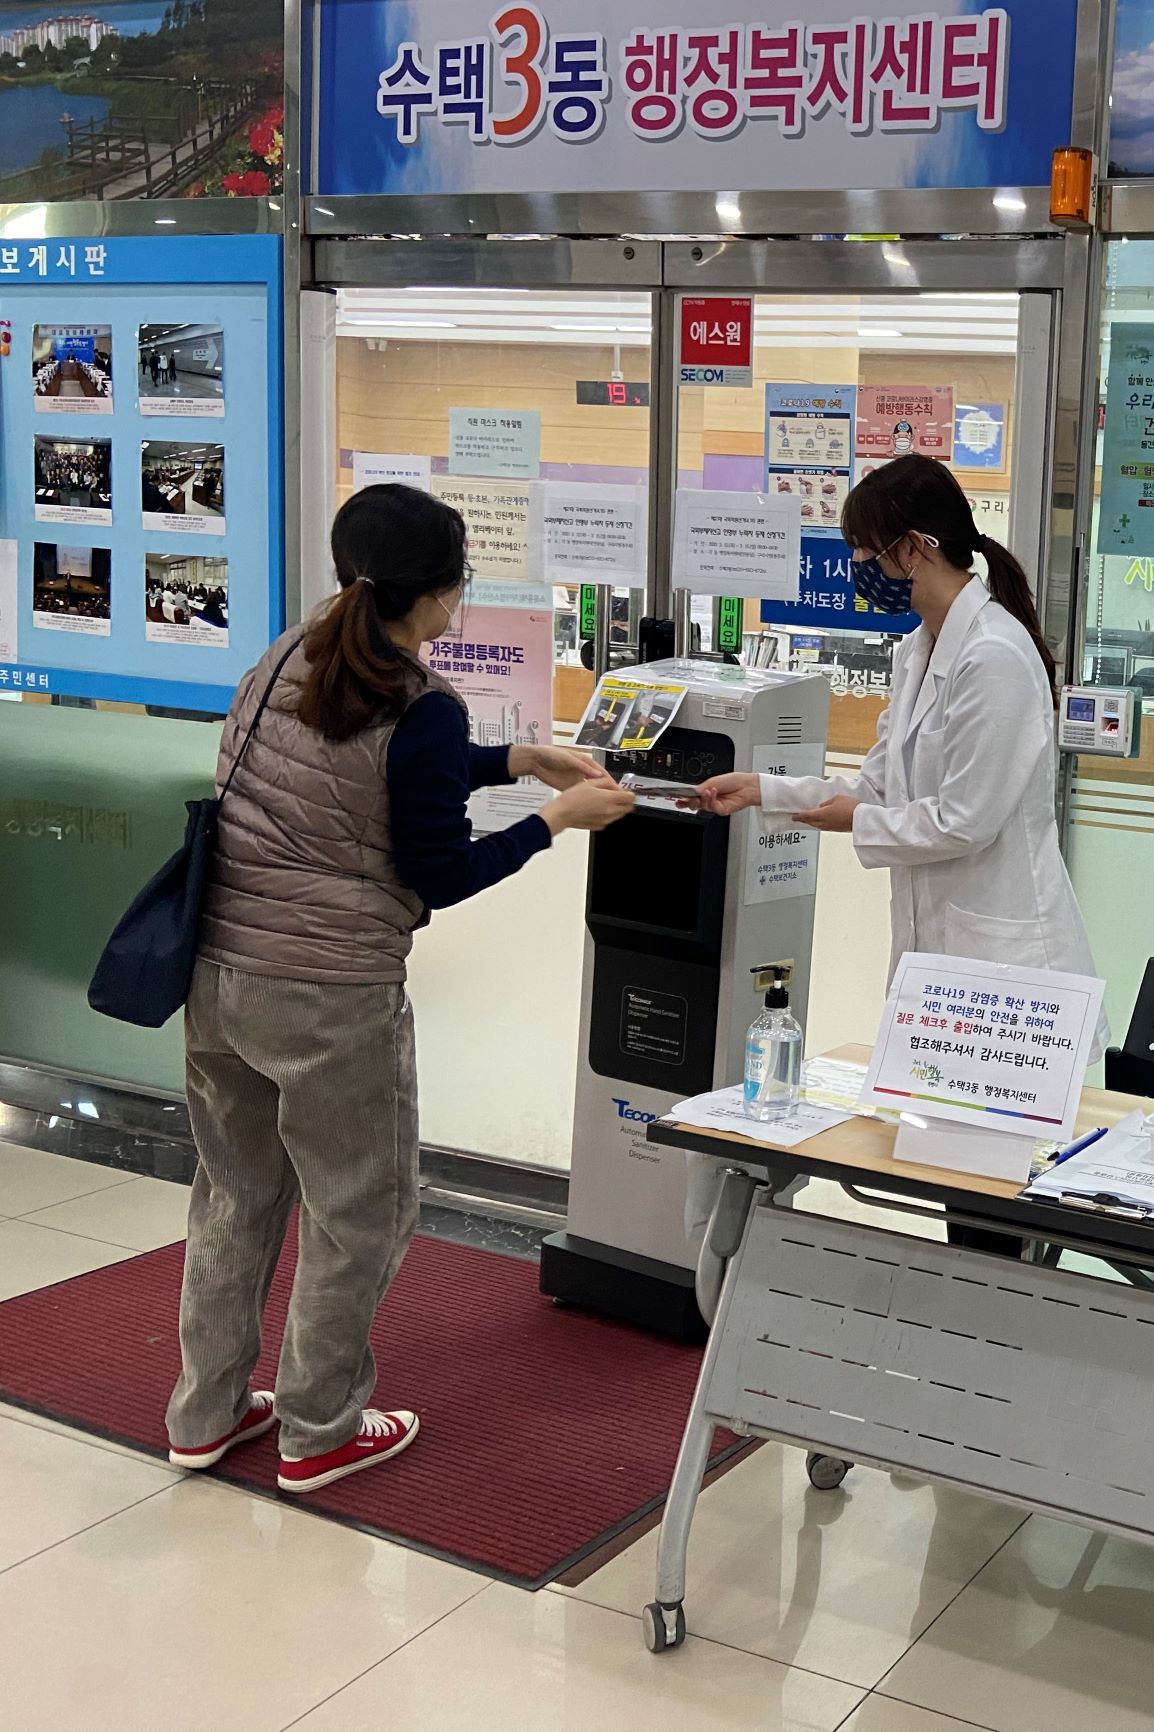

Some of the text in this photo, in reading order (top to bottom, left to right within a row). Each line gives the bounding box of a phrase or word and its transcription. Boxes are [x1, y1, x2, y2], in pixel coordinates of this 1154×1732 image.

[380, 6, 1002, 141] 수택3동 행정복지센터
[689, 320, 742, 346] 에스원
[680, 368, 724, 383] SECOM
[875, 402, 934, 416] 예방행동수칙
[467, 509, 492, 519] 원하시는
[489, 541, 521, 551] 이용하세요!
[823, 557, 852, 582] 1시
[723, 598, 735, 645] 미세요
[428, 640, 525, 664] 거주불명등록자도
[475, 662, 484, 675] 수
[485, 663, 511, 677] 있어요!
[830, 667, 893, 699] 행정복
[758, 831, 807, 848] 이용하세요~
[778, 859, 808, 871] 행정복지센터
[922, 984, 1061, 1015] 코로나19 감염증 확산 방지와
[922, 1000, 1055, 1031] 시민 여러분의 안전을 위하여
[896, 1011, 1075, 1052] 질문 체크후 출입하여 주시기 바랍니다.
[909, 1035, 1050, 1072] 협조해주셔서 감사드립니다.
[947, 1080, 1037, 1104] 수택3동 행정복지센터
[628, 1149, 661, 1164] Dispenser
[631, 1139, 660, 1153] Sanitizer
